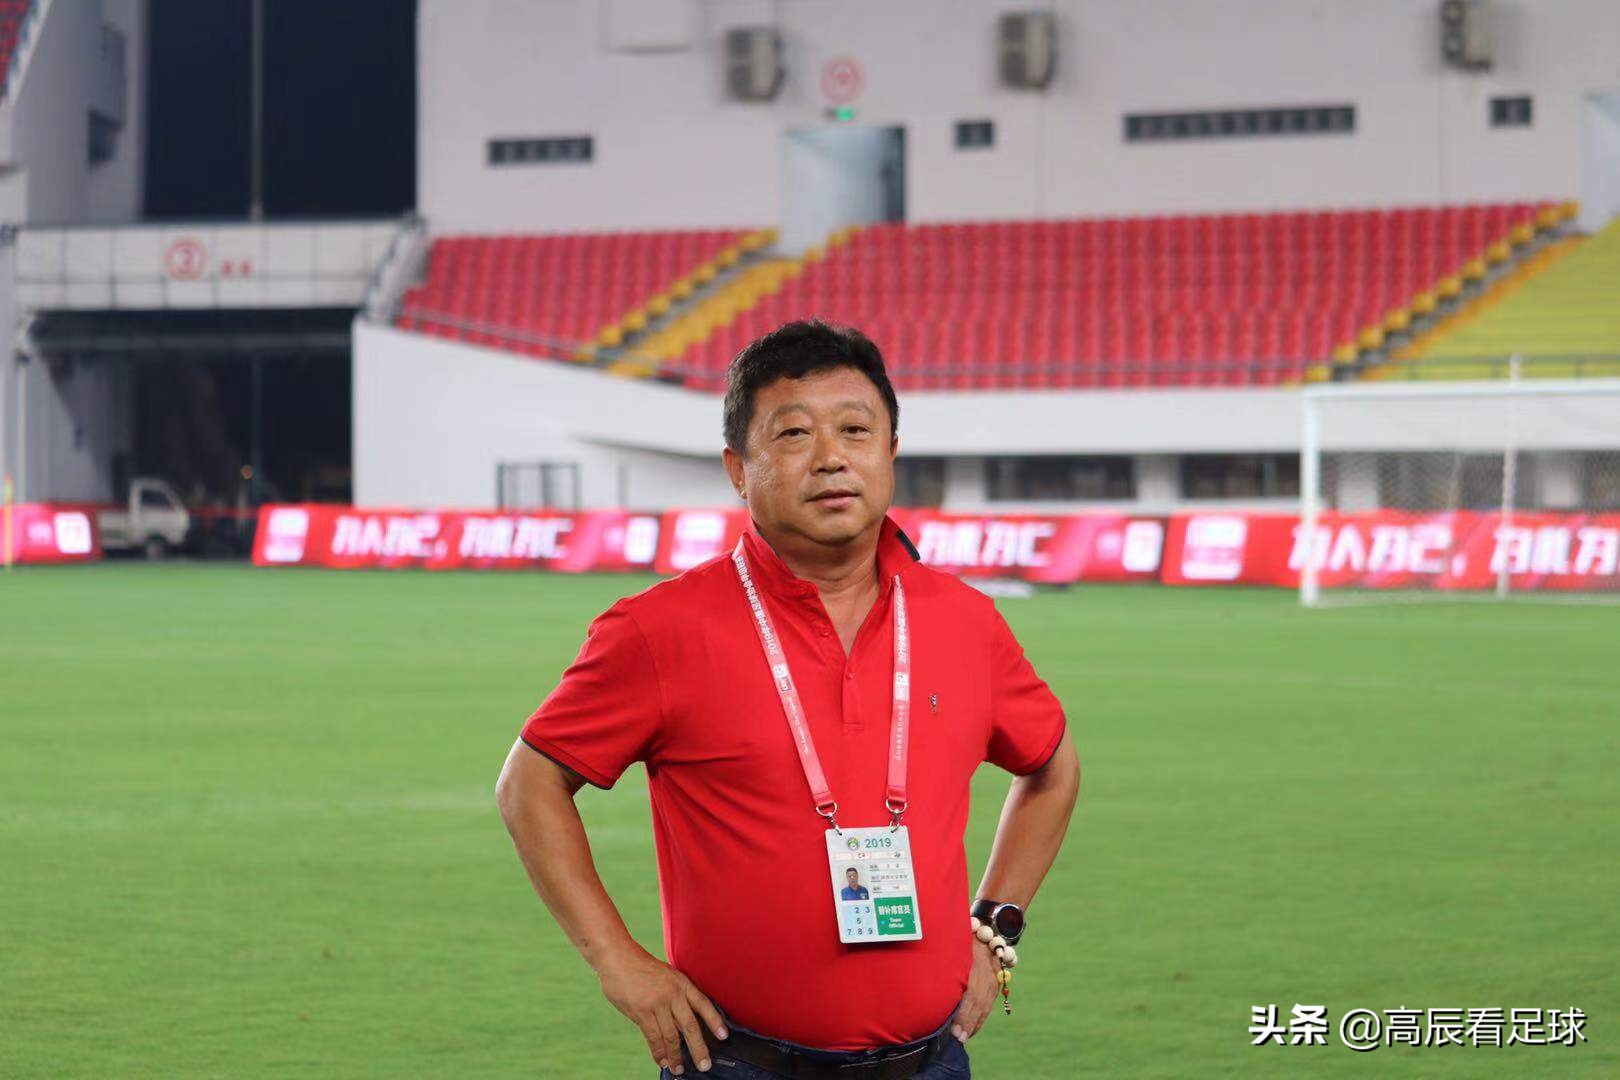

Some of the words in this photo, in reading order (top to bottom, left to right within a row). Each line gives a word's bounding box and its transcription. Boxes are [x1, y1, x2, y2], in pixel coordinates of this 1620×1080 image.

[865, 837, 892, 849] 2019
[854, 906, 860, 914] 2
[864, 906, 870, 914] 3
